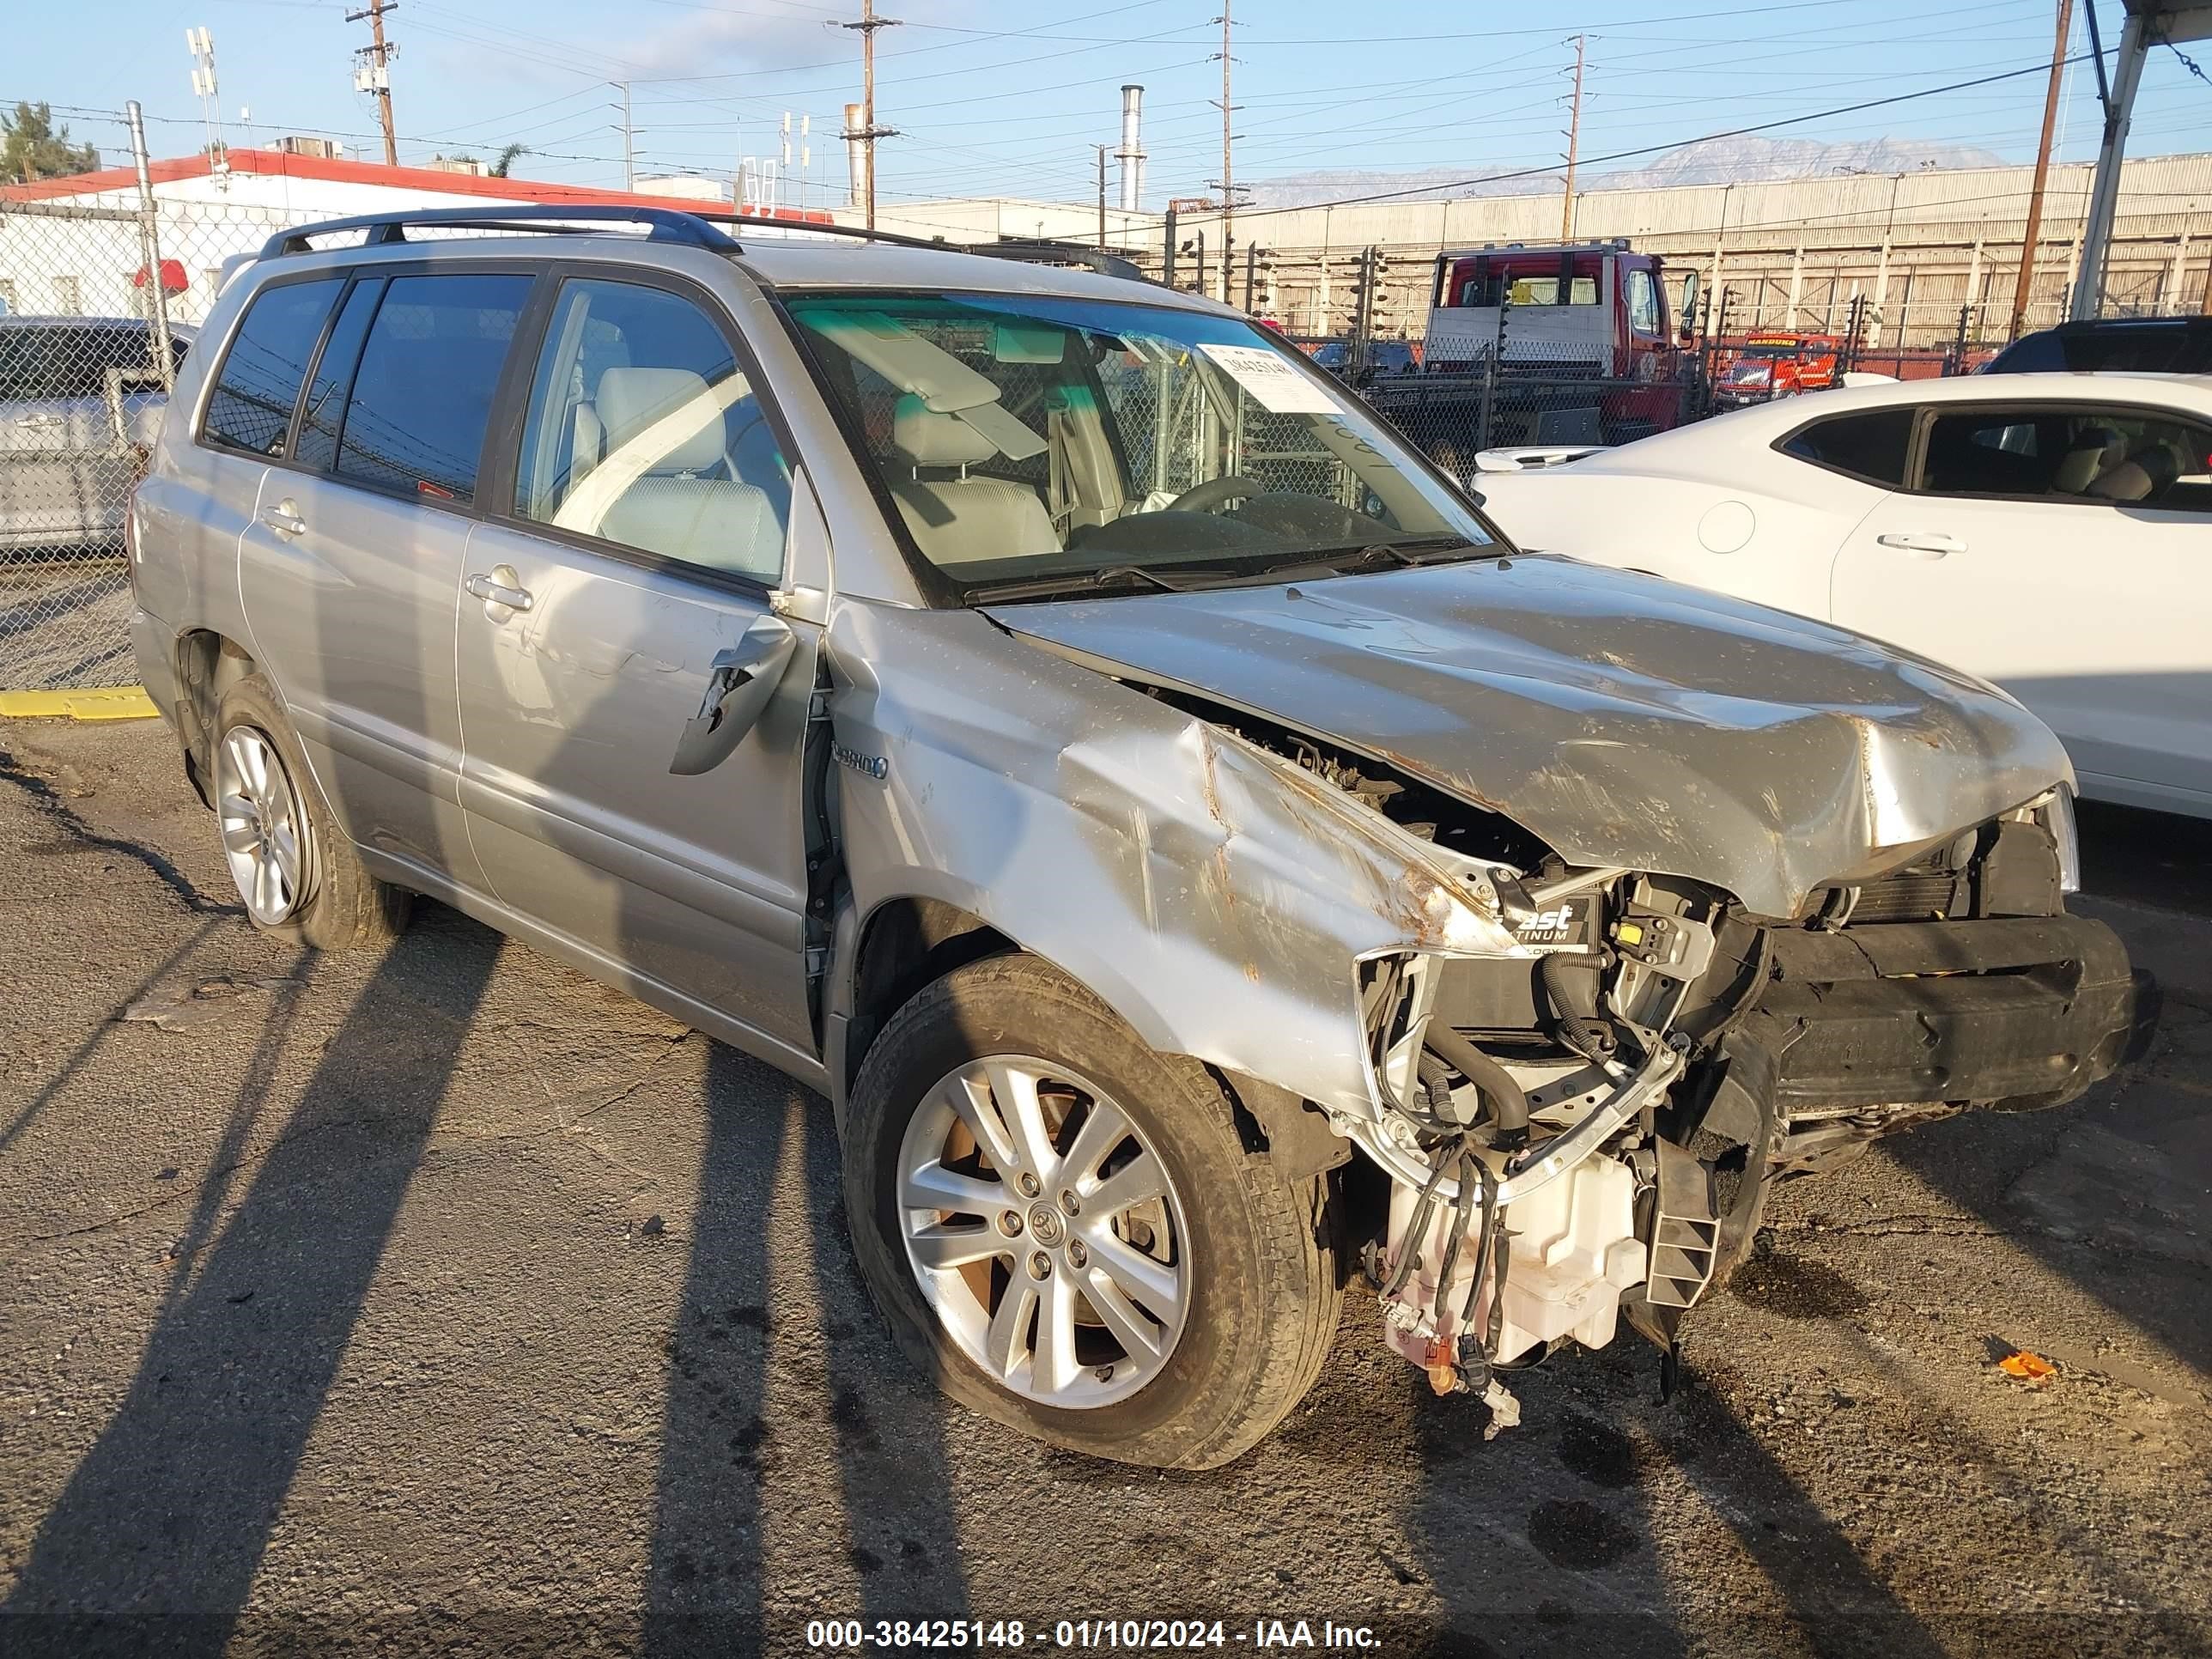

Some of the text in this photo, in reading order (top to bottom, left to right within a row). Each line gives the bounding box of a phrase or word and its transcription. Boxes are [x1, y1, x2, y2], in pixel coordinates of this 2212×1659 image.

[1224, 358, 1293, 376] 38425148
[1517, 904, 1573, 931] ast
[1516, 931, 1568, 941] TINUM
